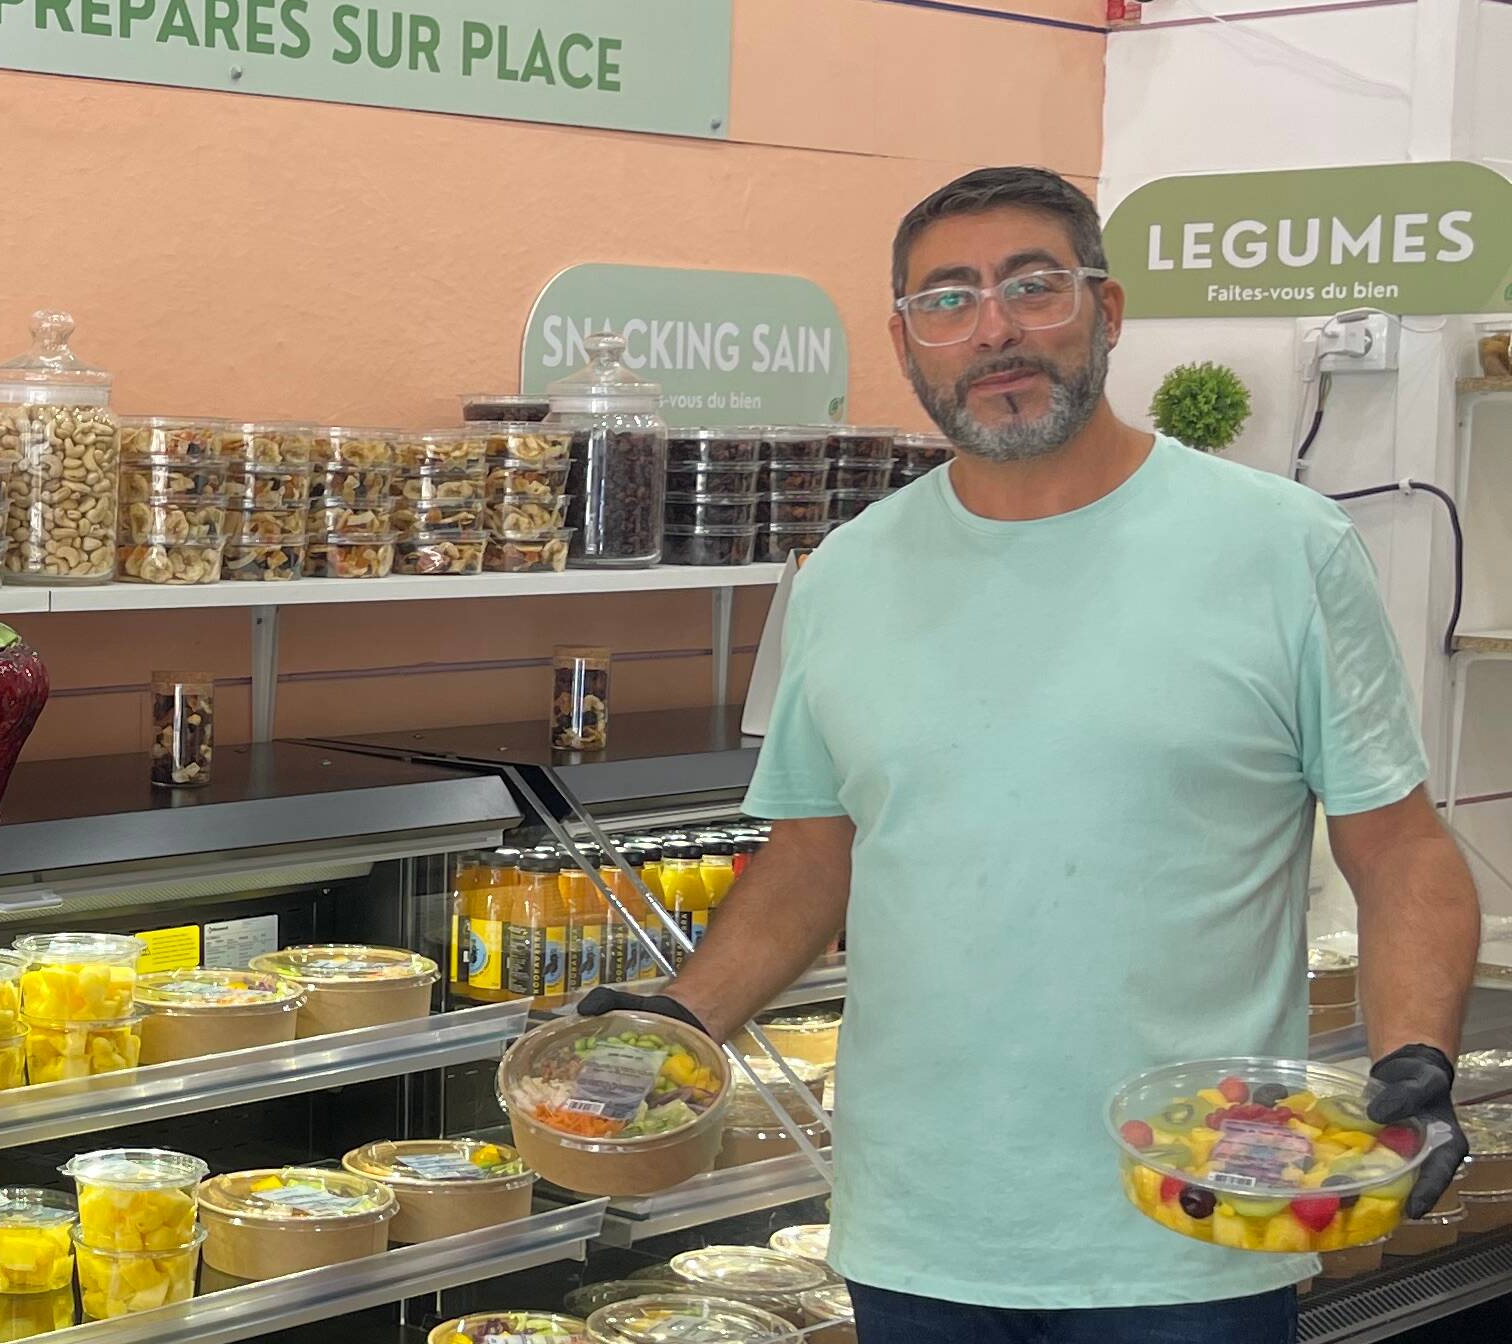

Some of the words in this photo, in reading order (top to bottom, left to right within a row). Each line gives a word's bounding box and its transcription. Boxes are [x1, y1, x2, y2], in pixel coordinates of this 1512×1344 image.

[331, 4, 442, 74] SUR
[460, 20, 624, 94] PLACE
[1148, 210, 1474, 272] LEGUMES
[1207, 281, 1315, 303] Faites-vous
[1321, 282, 1347, 299] du
[1353, 281, 1399, 299] bien
[752, 323, 831, 374] SAIN
[708, 391, 726, 409] du
[730, 391, 761, 409] bien
